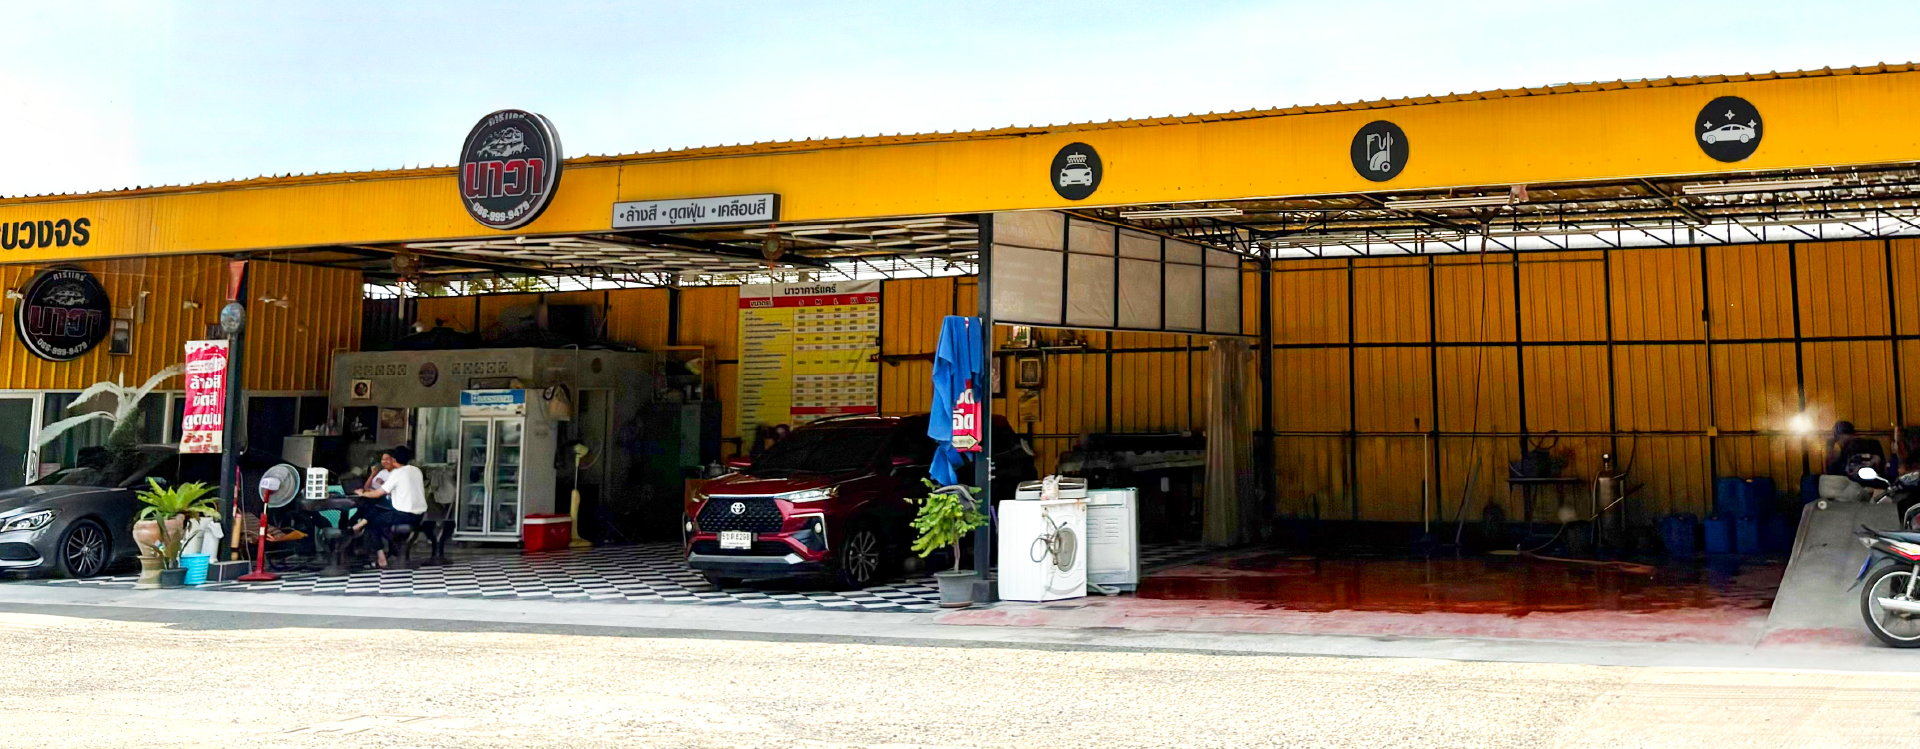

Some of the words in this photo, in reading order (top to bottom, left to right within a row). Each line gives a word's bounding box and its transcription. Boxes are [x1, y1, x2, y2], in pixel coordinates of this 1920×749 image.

[464, 157, 544, 200] นาวา
[472, 200, 530, 222] 086-999-9479
[626, 203, 658, 222] ล้างสี
[668, 201, 706, 225] ดูดฝุ่น
[717, 197, 767, 217] เคลือบสี
[0, 217, 91, 250] บวงจร
[28, 305, 102, 338] นาวา
[189, 374, 222, 390] ล้างสี
[206, 432, 213, 442] 5
